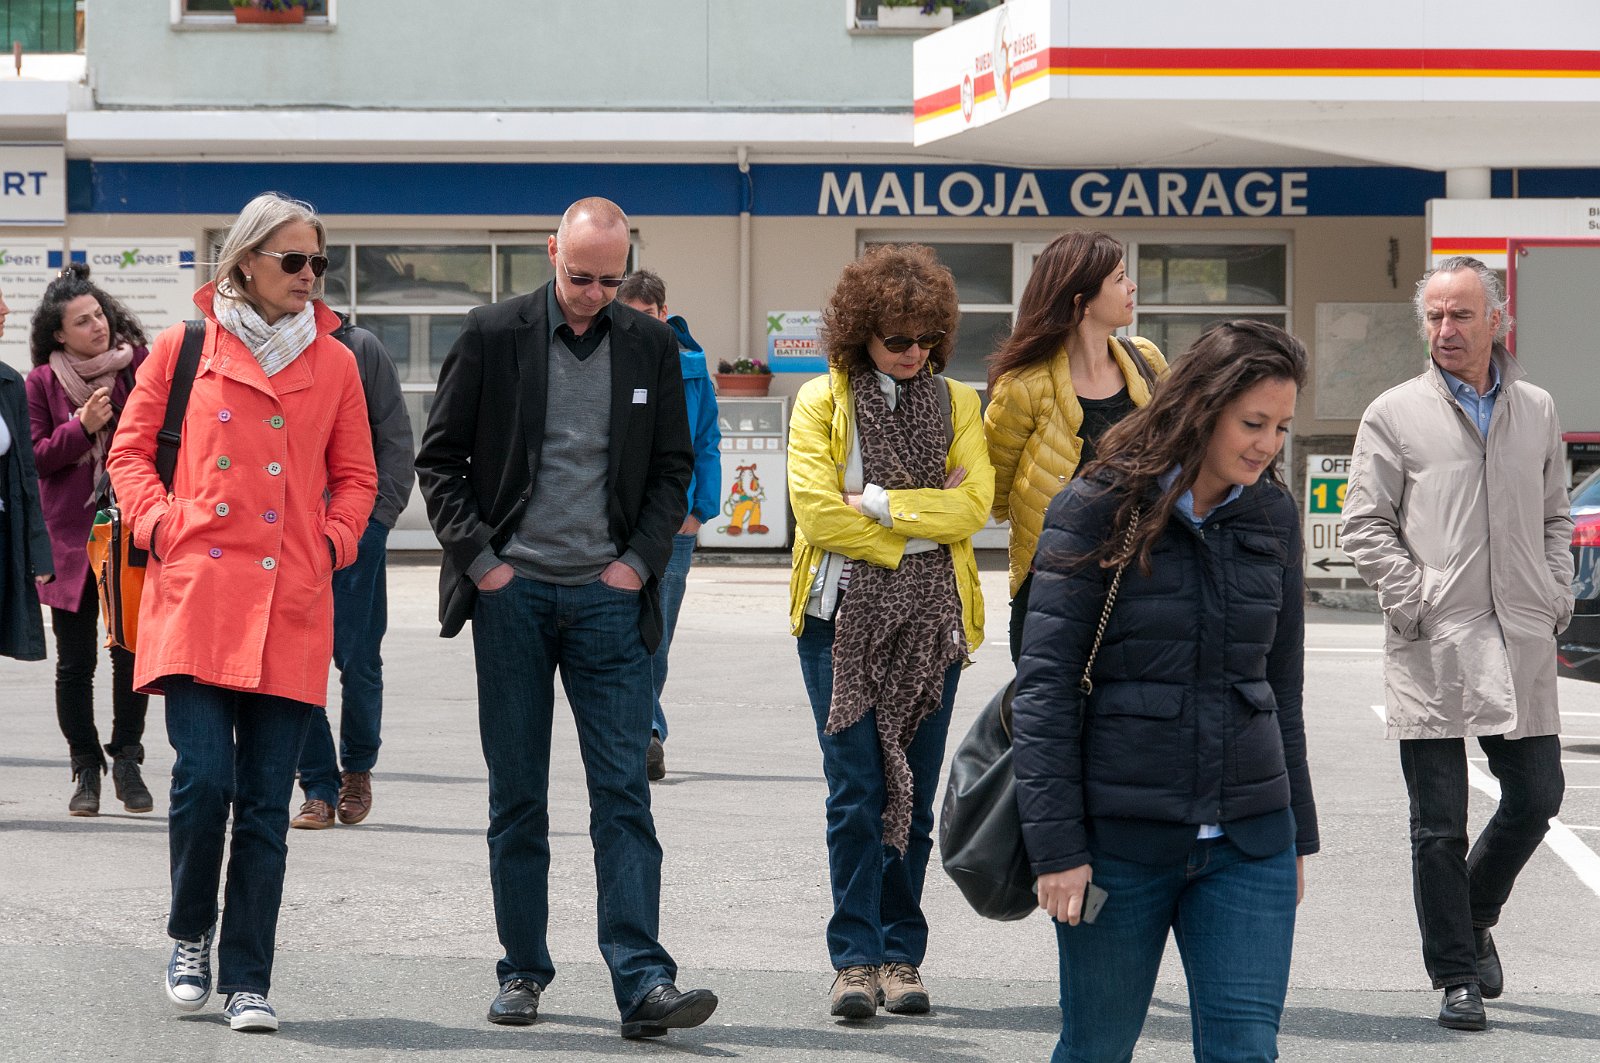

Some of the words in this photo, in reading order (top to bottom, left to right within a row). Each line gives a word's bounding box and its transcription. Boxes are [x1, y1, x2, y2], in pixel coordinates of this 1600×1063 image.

[2, 171, 47, 196] RT
[817, 171, 1050, 217] MALOJA
[1070, 171, 1309, 217] GARAGE
